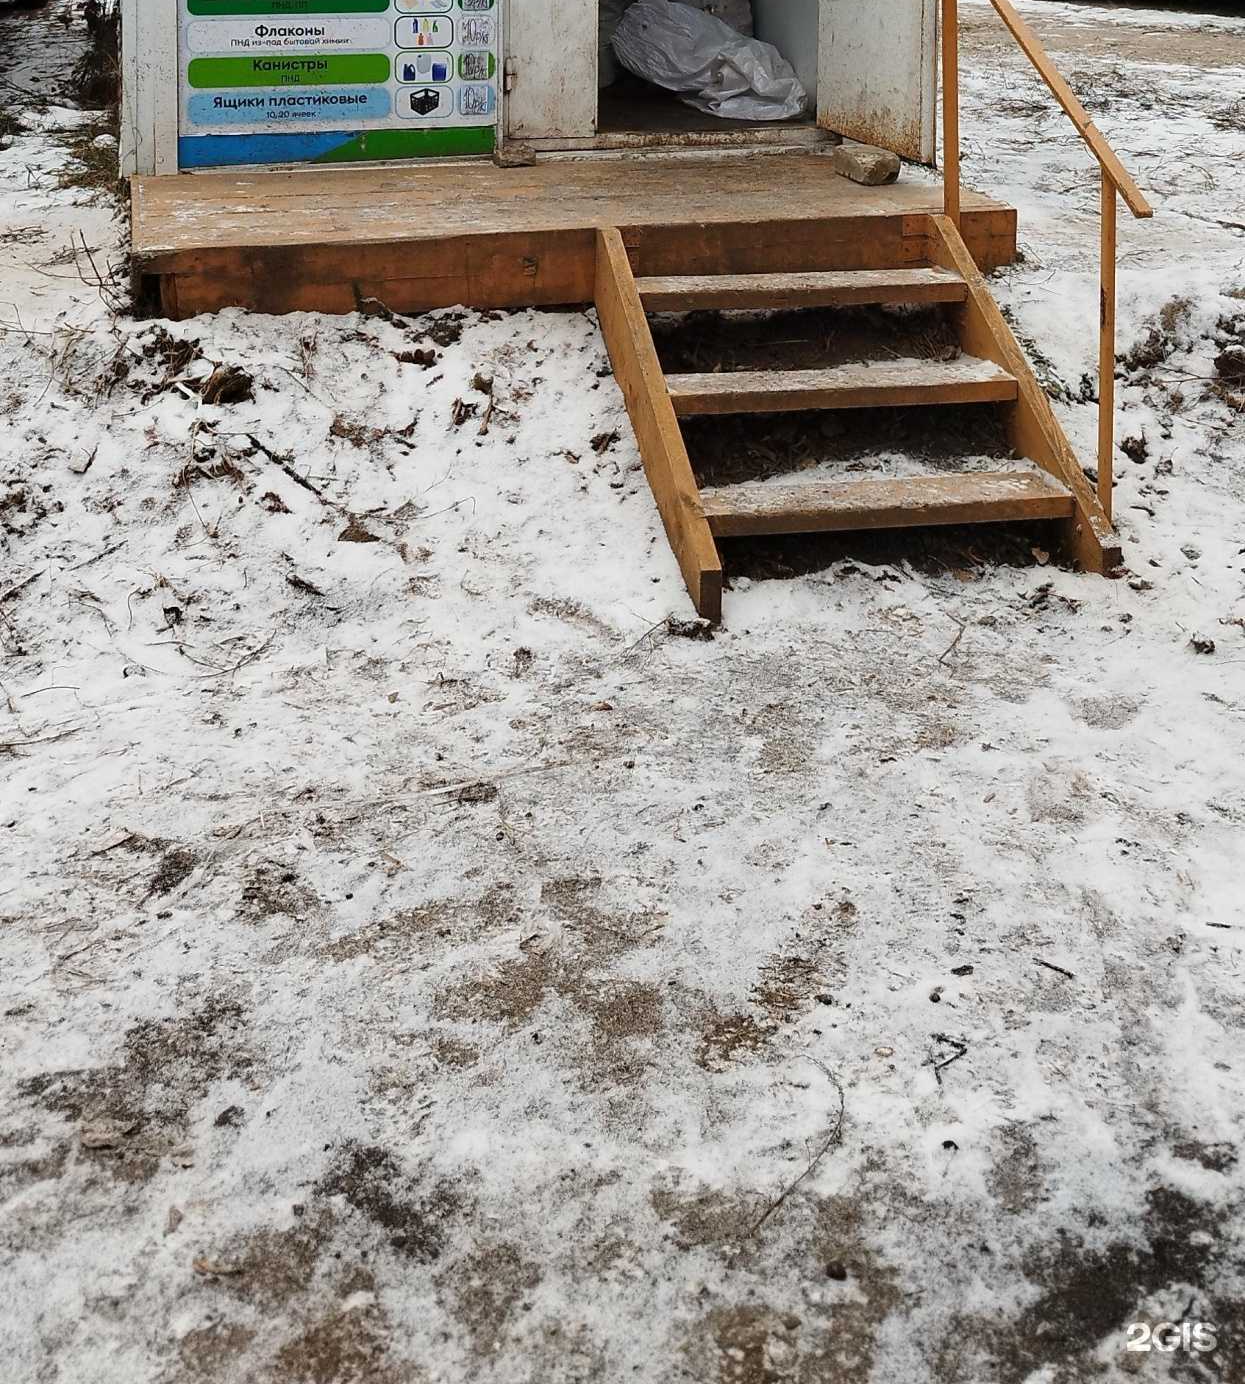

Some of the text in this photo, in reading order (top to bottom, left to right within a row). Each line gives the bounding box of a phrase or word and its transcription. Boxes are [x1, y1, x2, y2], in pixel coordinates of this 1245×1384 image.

[254, 24, 325, 38] Флаконы
[230, 39, 250, 47] ПНД
[251, 38, 282, 47] из-под
[283, 37, 320, 46] бытовой
[253, 59, 328, 73] Канистры
[281, 74, 300, 83] ПНД
[213, 93, 368, 110] Ящики пластиковые
